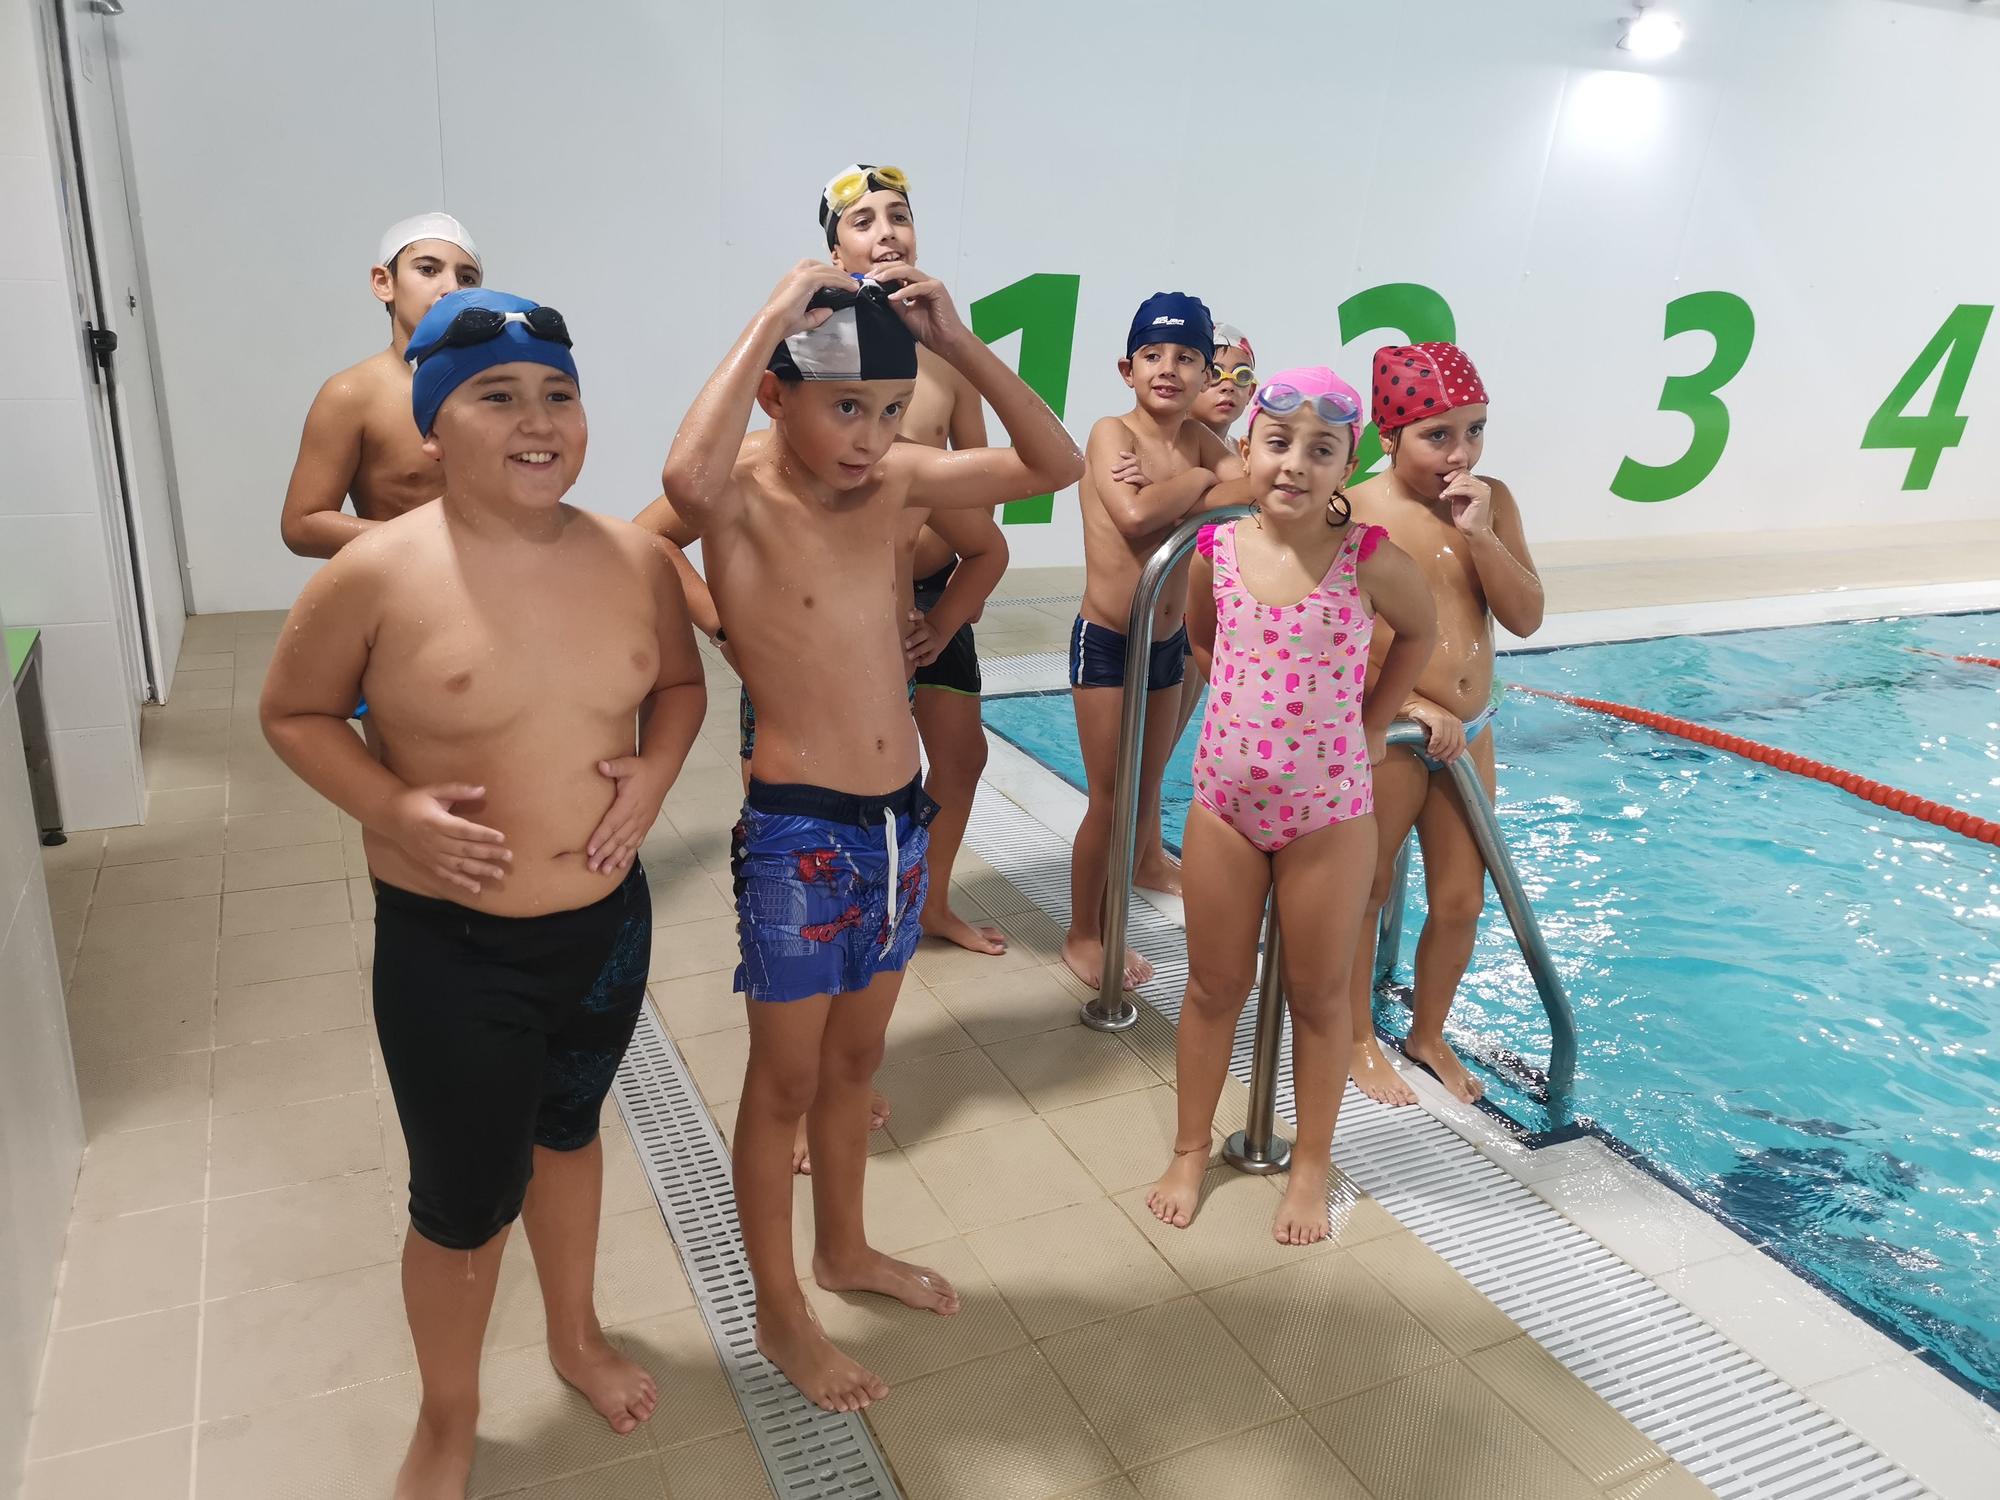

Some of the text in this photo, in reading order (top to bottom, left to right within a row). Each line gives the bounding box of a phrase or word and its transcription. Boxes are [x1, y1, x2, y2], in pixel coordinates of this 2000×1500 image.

[970, 273, 1994, 525] 1 2 3 4
